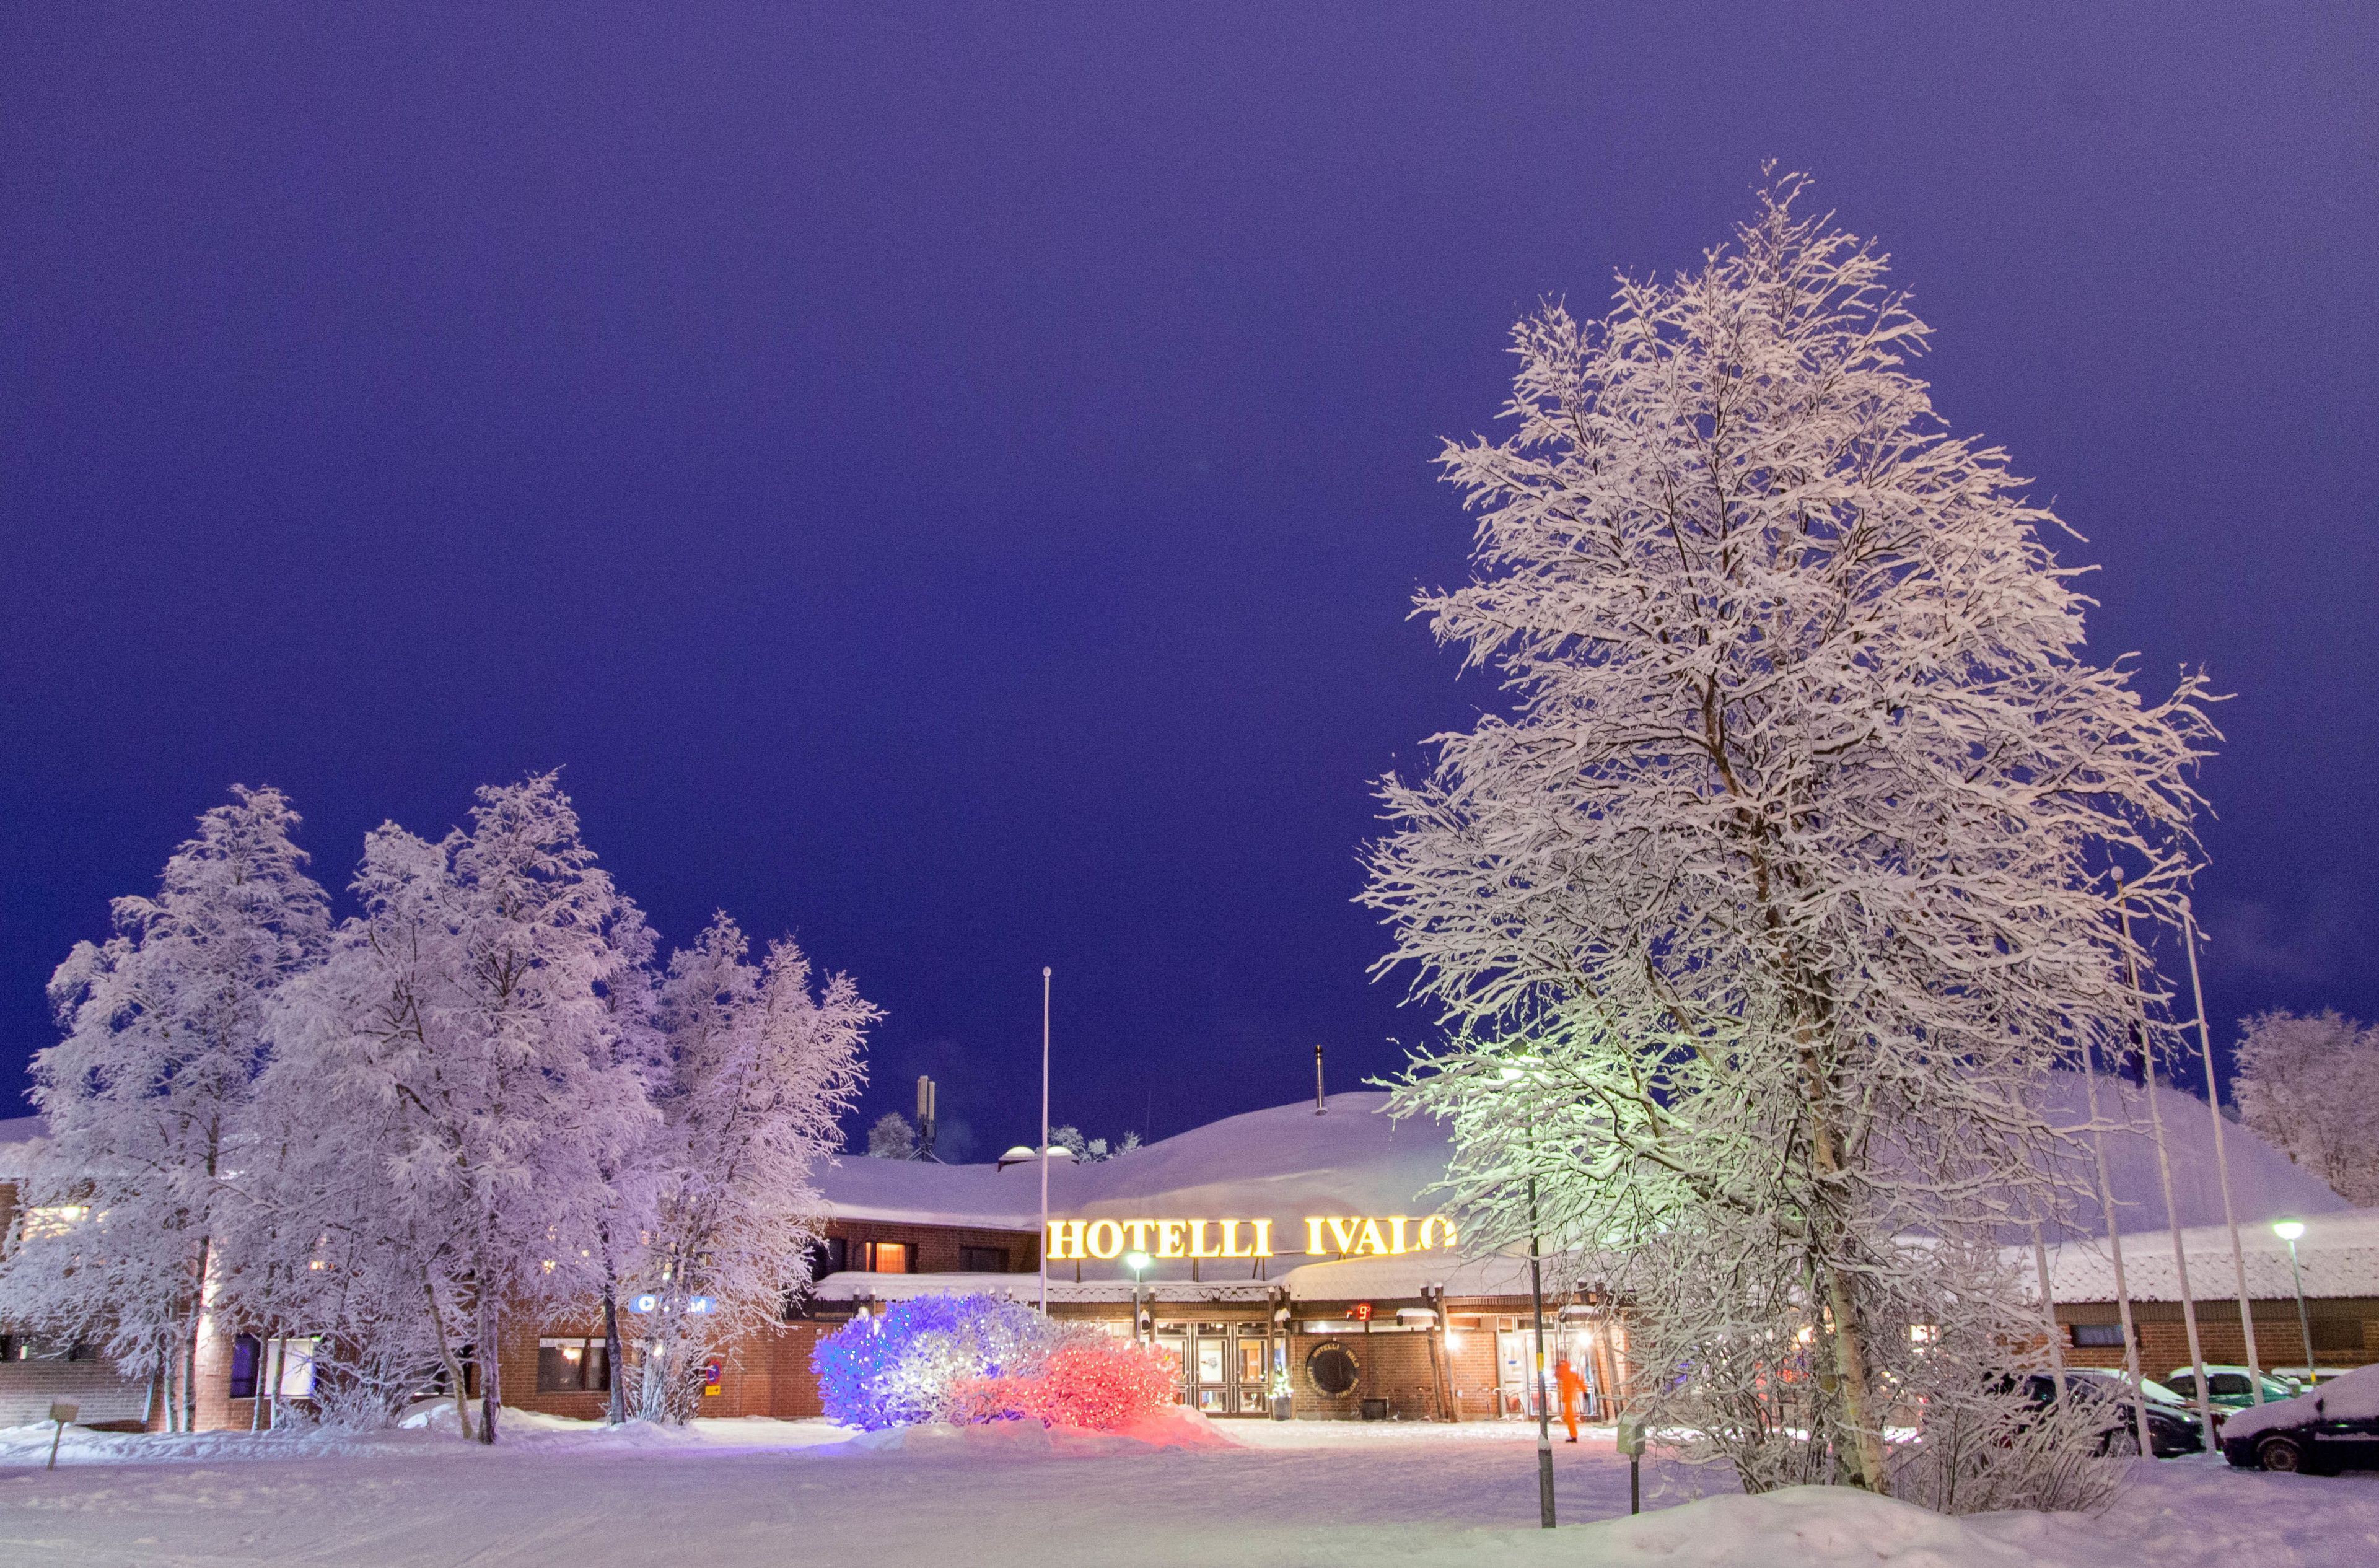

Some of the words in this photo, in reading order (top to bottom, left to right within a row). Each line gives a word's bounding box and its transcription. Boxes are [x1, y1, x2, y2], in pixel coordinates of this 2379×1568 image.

[1046, 1219, 1273, 1259] HOTELLI
[1313, 1344, 1339, 1358] HOTELLI
[1346, 1350, 1359, 1368] IVALO
